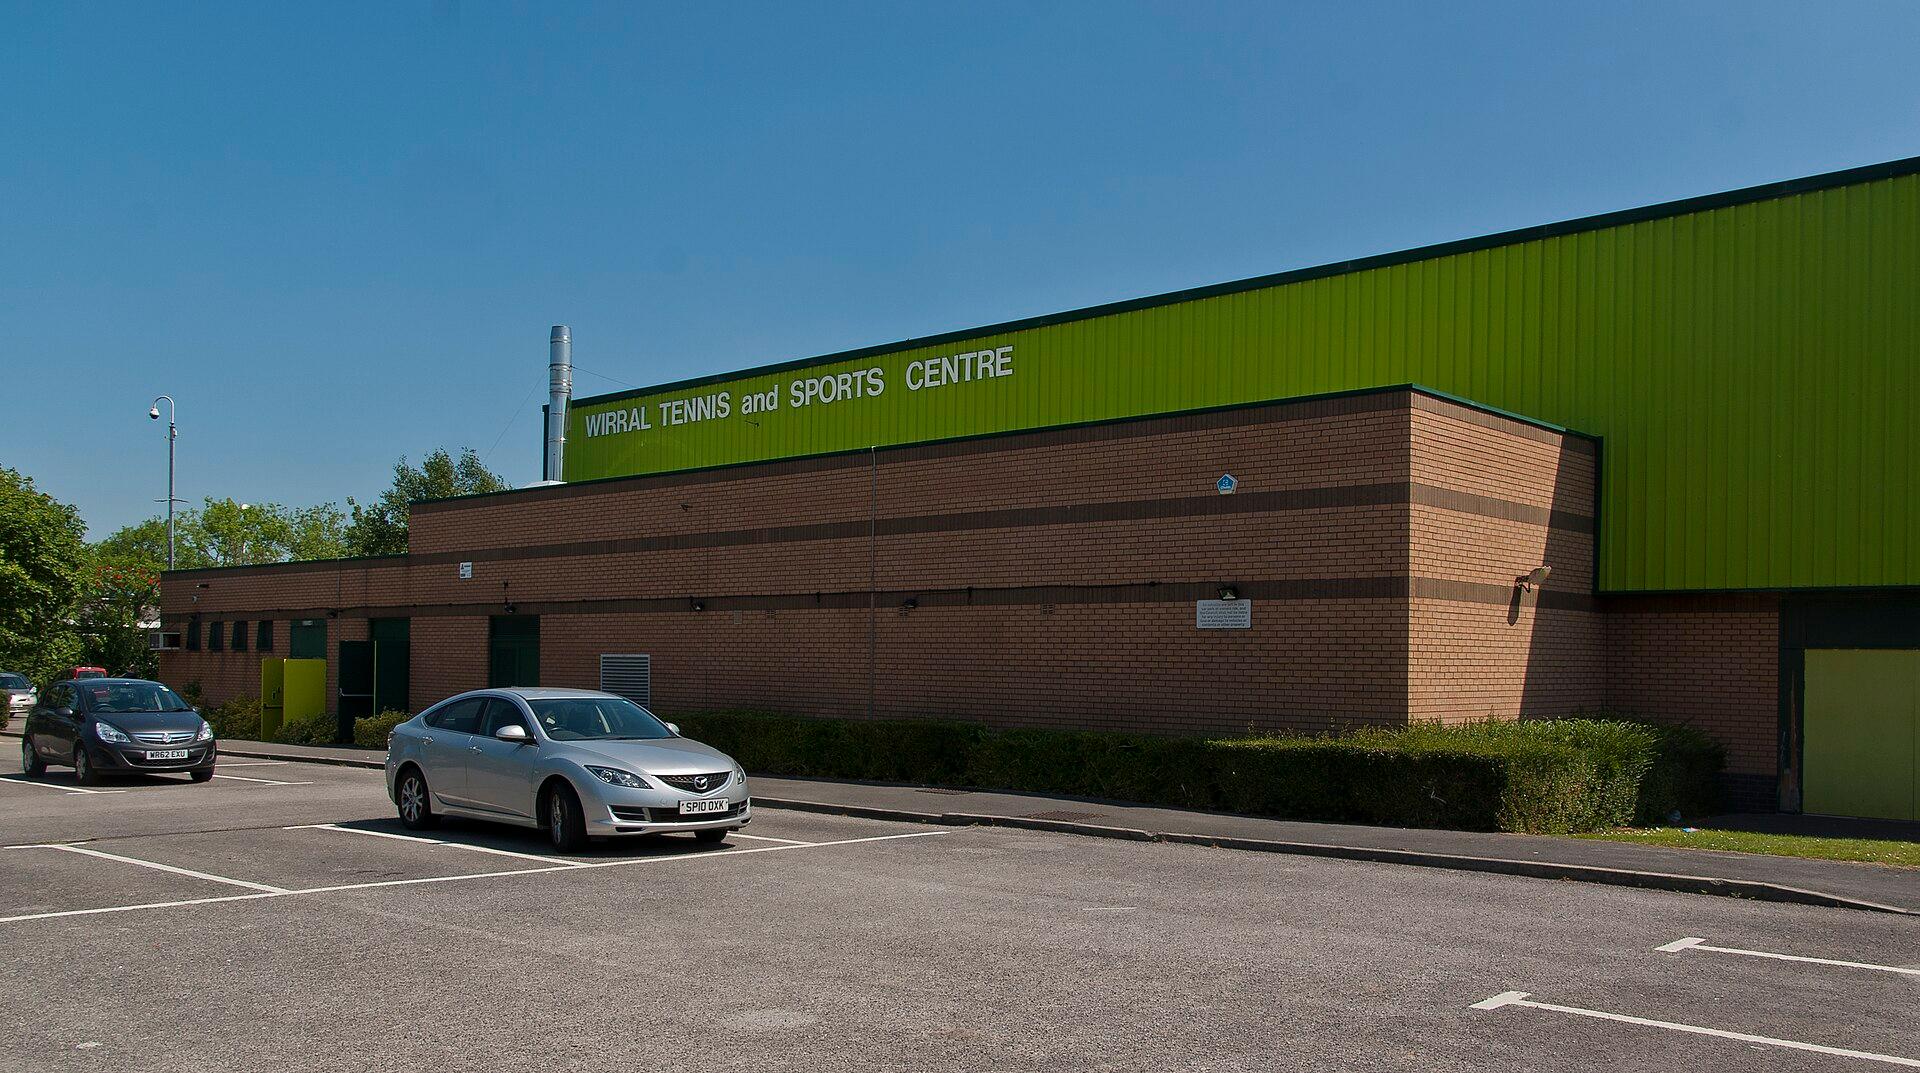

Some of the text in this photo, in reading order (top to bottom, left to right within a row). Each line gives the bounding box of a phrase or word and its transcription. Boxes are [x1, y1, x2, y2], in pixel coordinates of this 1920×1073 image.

[585, 346, 1014, 438] WIRRAL TENNIS and SPORTS CENTRE
[149, 750, 186, 759] WR62 EXU
[686, 800, 724, 812] SP10 OXK
